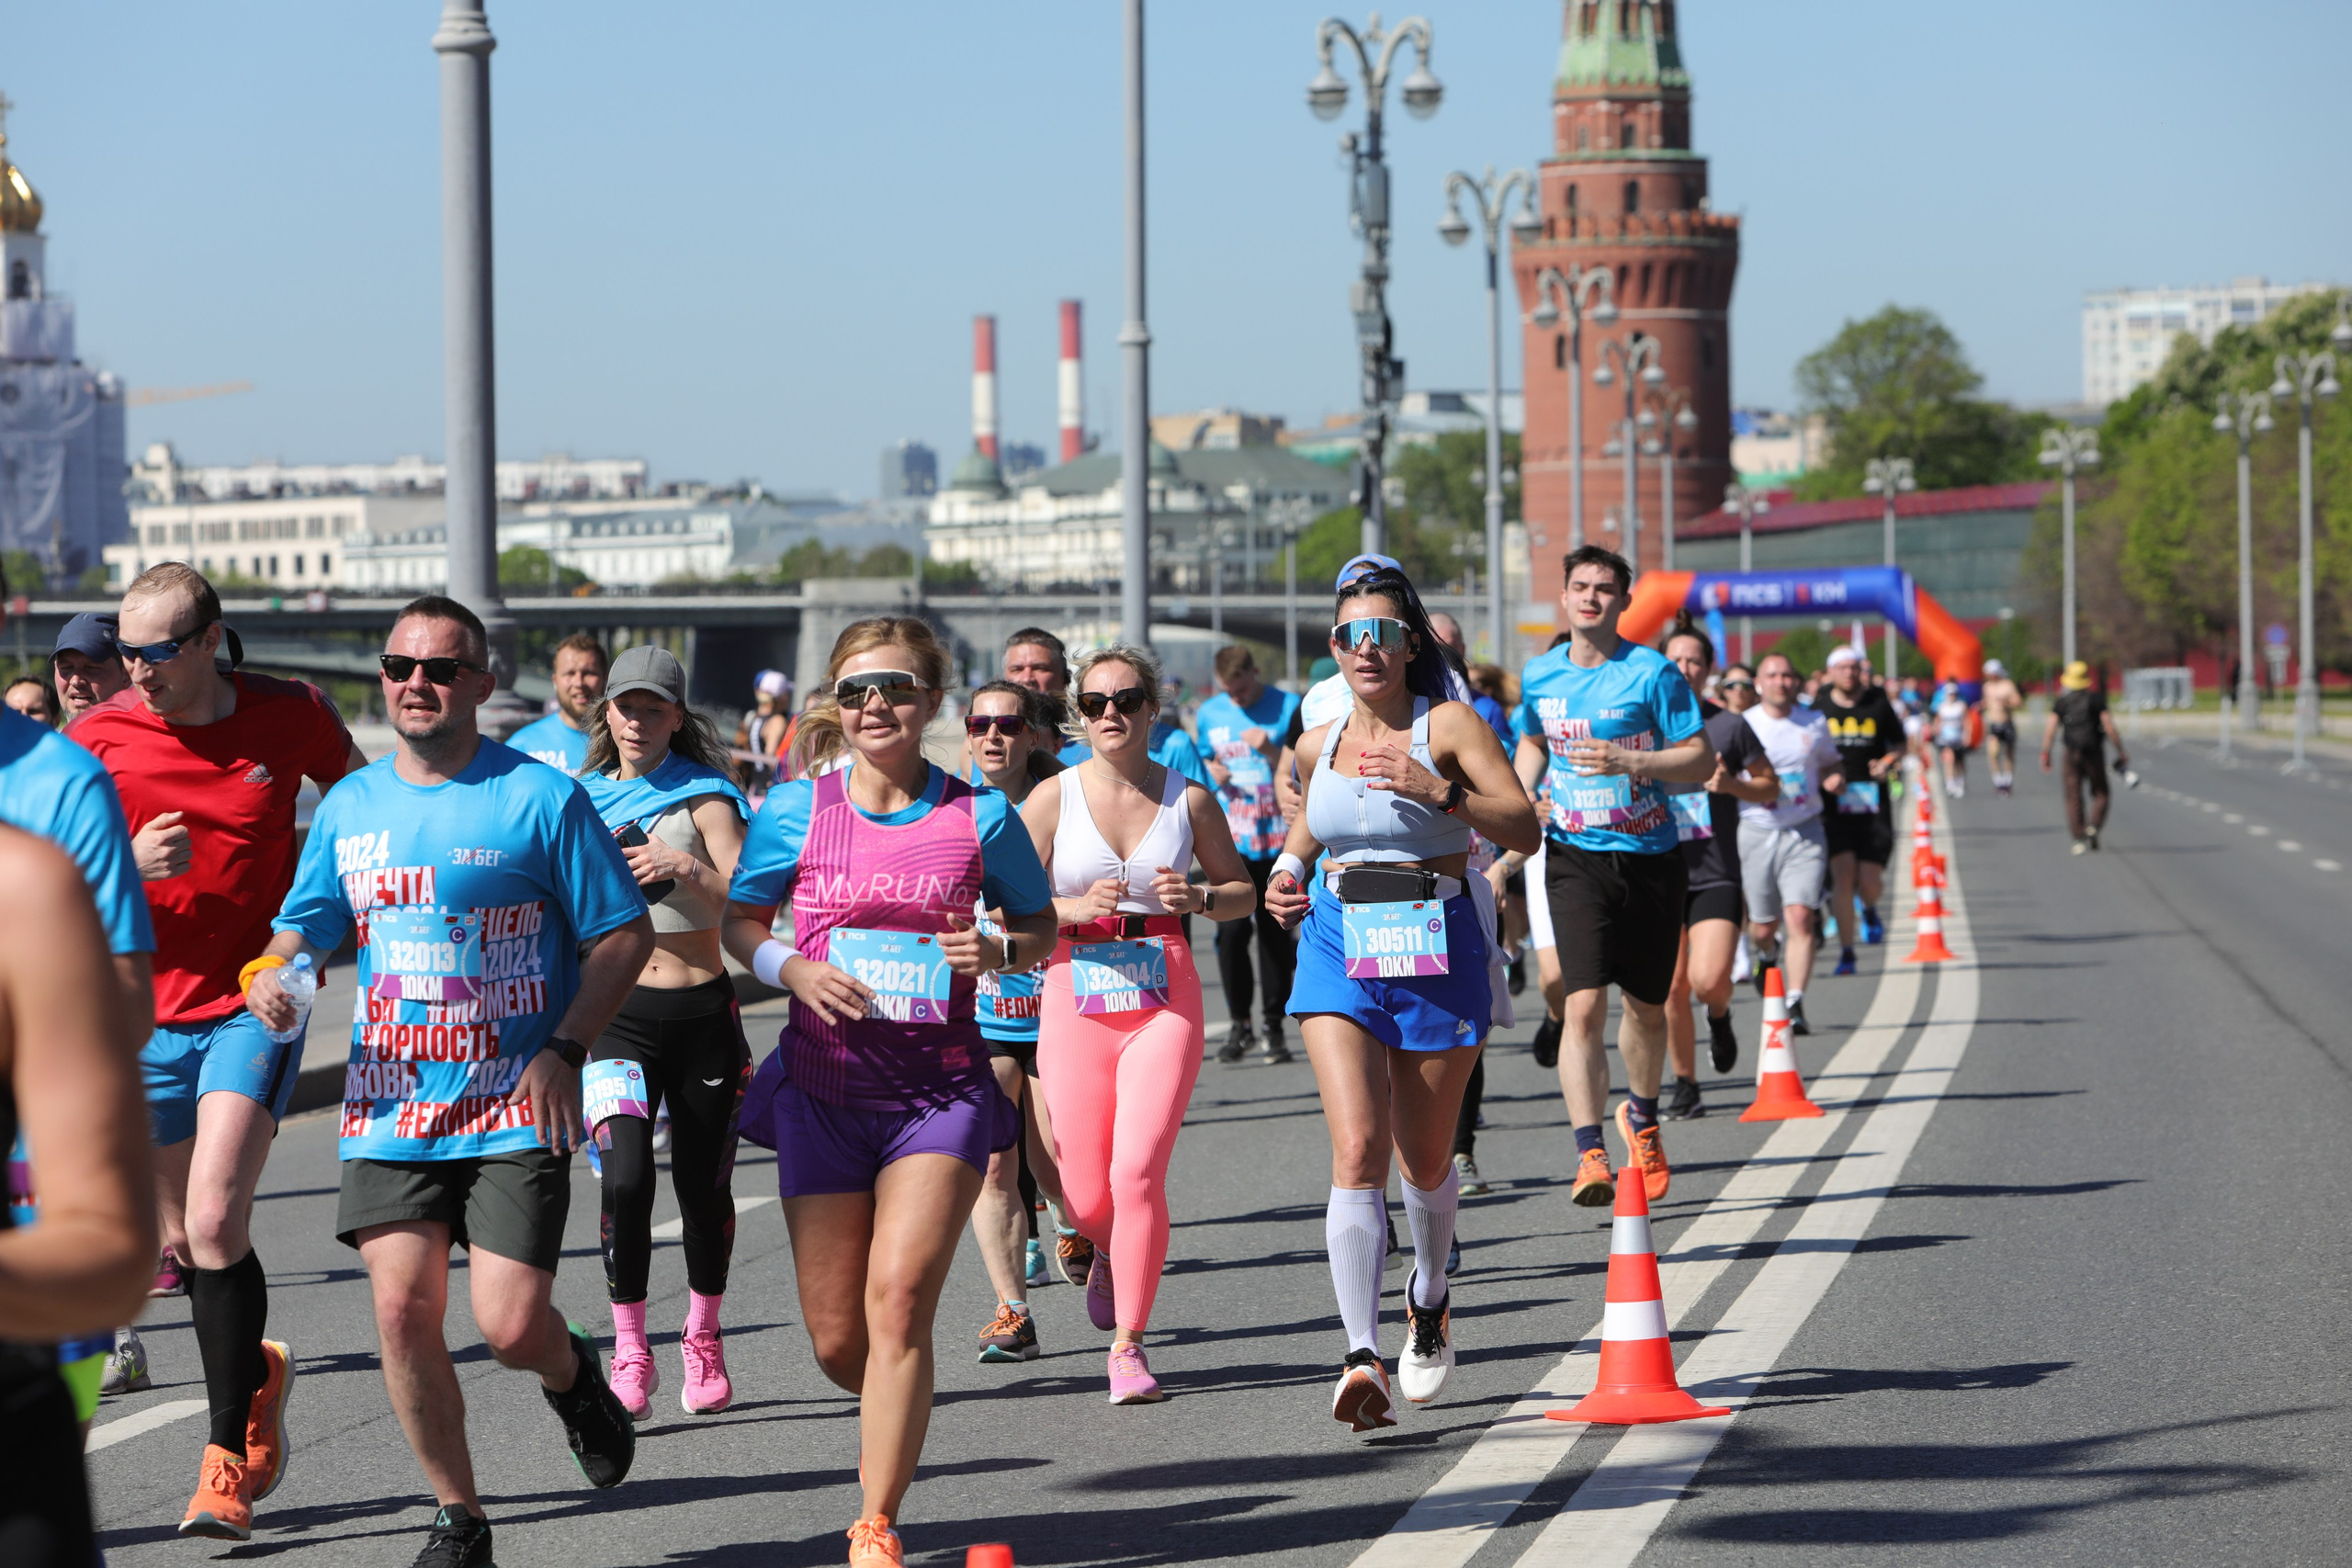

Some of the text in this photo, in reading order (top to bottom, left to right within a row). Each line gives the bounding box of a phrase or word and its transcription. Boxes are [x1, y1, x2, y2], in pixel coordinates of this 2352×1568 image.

[1538, 697, 1567, 719] 2024
[1573, 787, 1615, 809] 31275
[335, 830, 390, 876] 2024
[345, 866, 435, 910] #МЕЧТА
[451, 929, 462, 941] C
[847, 932, 866, 941] ПСБ
[1365, 925, 1423, 954] 30511
[1430, 920, 1439, 931] C
[389, 940, 456, 973] 32013
[487, 935, 542, 982] 2024
[854, 958, 926, 994] 32021
[1089, 962, 1150, 991] 32004
[1156, 975, 1163, 984] D
[915, 1005, 926, 1017] C
[462, 1054, 523, 1097] 2024
[629, 1070, 639, 1079] C
[396, 1094, 537, 1138] #ЕДИНСТВ
